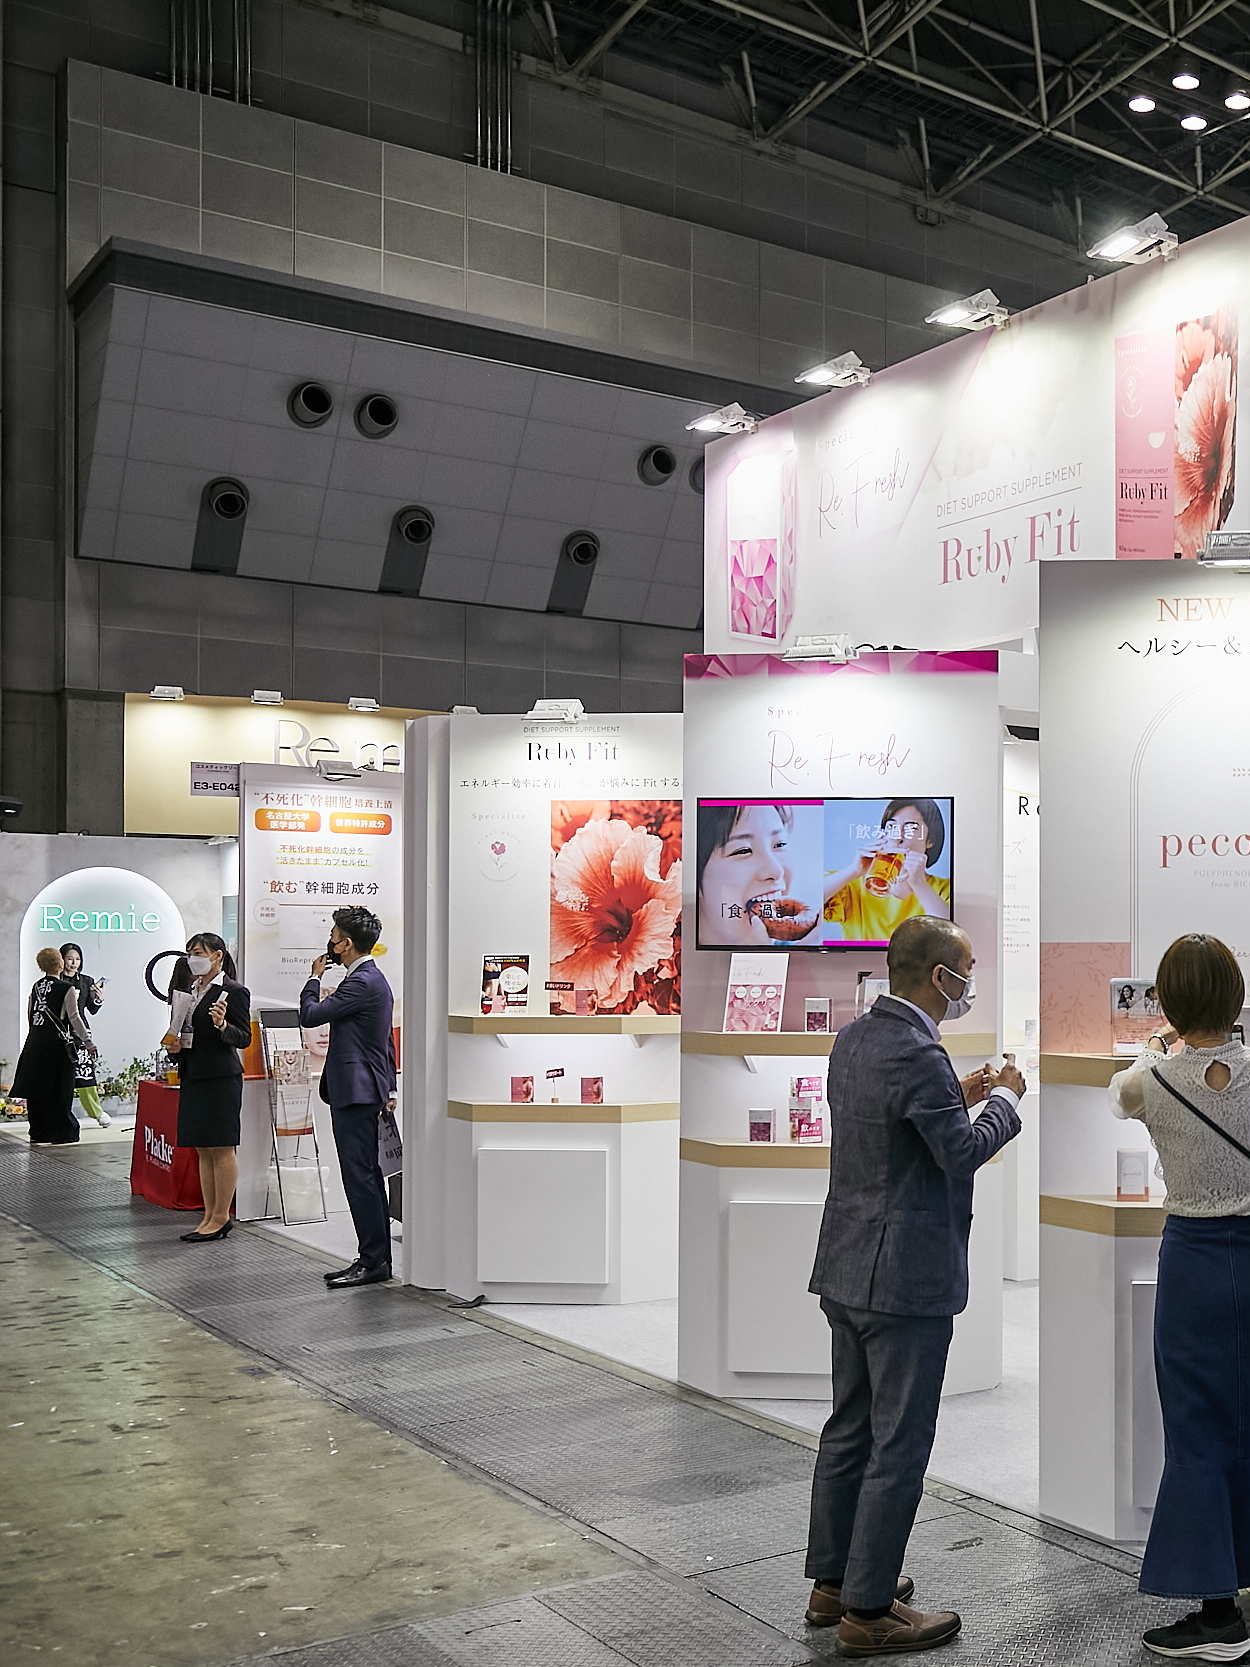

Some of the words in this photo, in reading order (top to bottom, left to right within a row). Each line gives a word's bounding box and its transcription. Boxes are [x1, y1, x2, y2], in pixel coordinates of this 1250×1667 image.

[937, 498, 958, 518] DIET
[961, 484, 1008, 511] SUPPORT
[1011, 462, 1083, 496] SUPPLEMENT
[1119, 482, 1147, 505] Ruby
[1150, 482, 1168, 500] Fit
[938, 527, 1019, 585] Ruby
[1024, 506, 1081, 564] Fit
[1157, 597, 1235, 622] NEW
[527, 742, 579, 766] Ruby
[588, 742, 620, 761] Fit
[265, 811, 310, 821] 名古屋大学
[270, 821, 306, 831] 医学部発
[335, 818, 386, 829] 世界特許成分
[472, 812, 526, 820] Specialize
[1211, 880, 1231, 888] from
[38, 903, 161, 932] Remie
